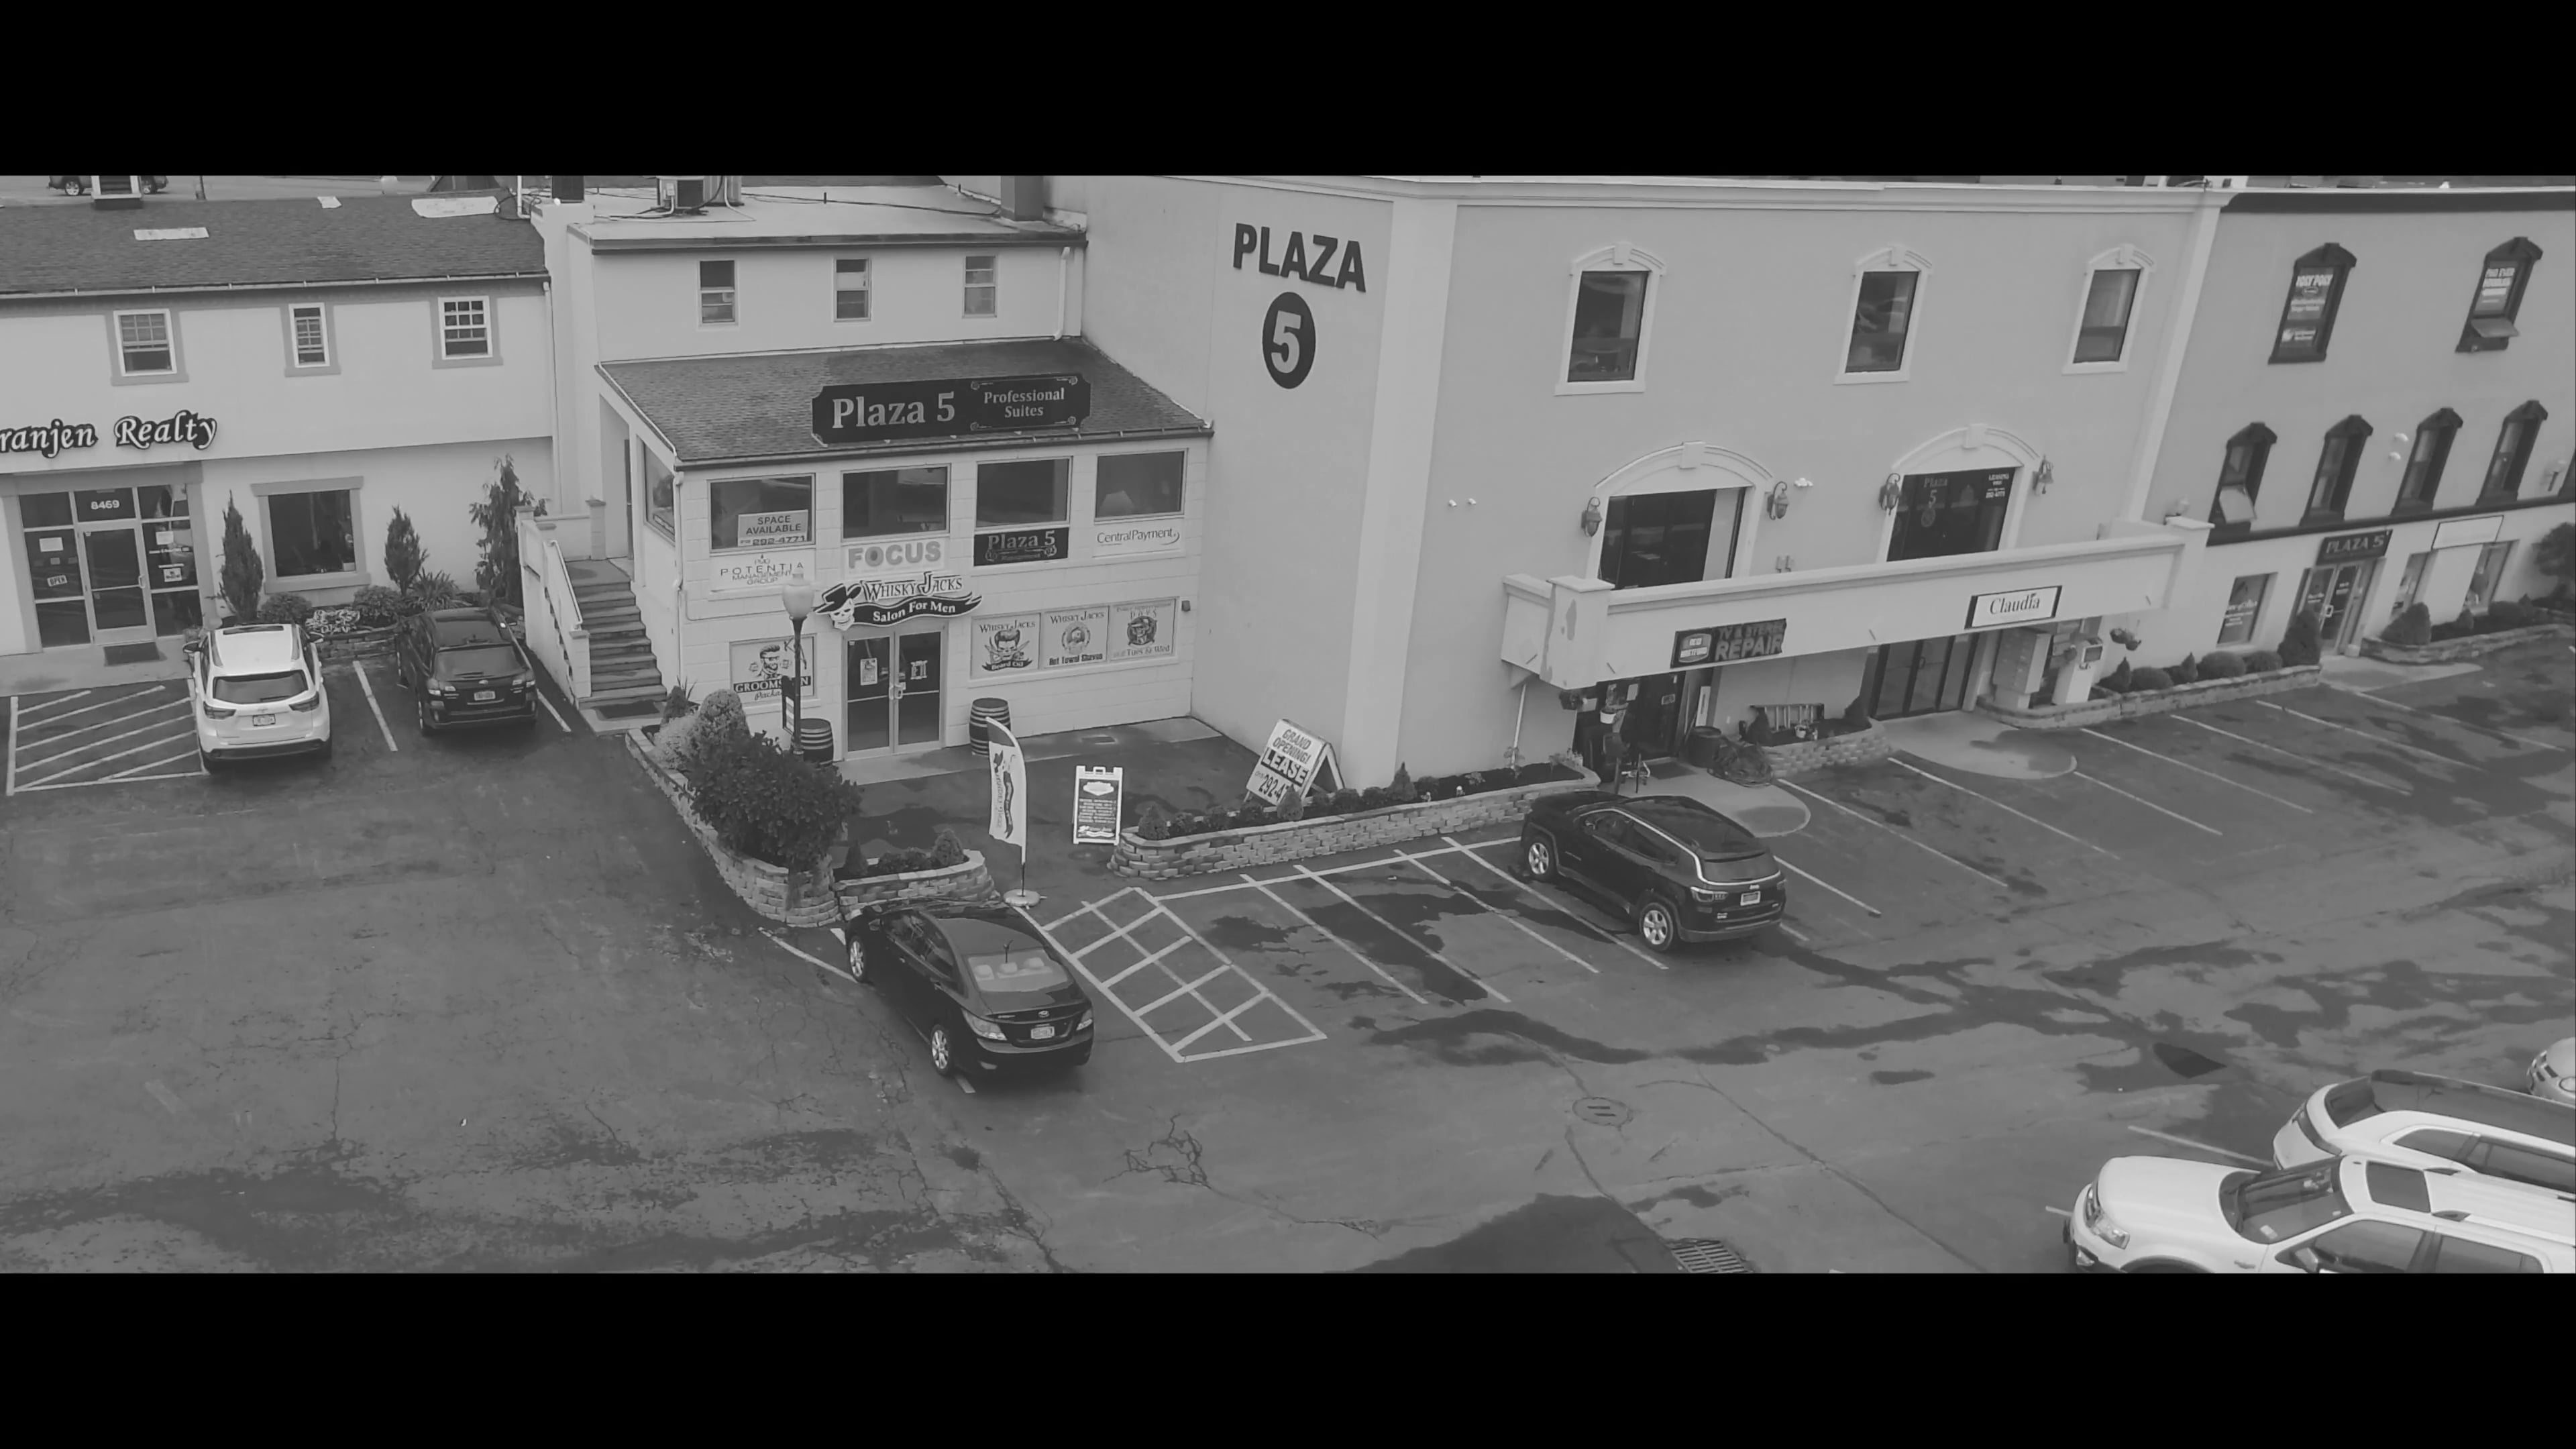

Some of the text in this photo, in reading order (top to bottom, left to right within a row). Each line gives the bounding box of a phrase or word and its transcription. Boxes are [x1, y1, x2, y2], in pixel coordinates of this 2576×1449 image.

[1233, 223, 1366, 292] PLAZA
[1271, 311, 1301, 373] 5
[983, 388, 1065, 404] Professional
[832, 391, 955, 429] Plaza 5
[1005, 405, 1044, 418] Suites
[115, 411, 217, 449] Realty
[91, 500, 119, 510] 8469
[746, 523, 801, 535] AVAILABLE
[757, 515, 791, 525] SPACE
[987, 530, 1055, 550] Plaza 5
[2326, 535, 2384, 553] PLAZA 5
[848, 541, 941, 569] FOCUS
[720, 562, 804, 576] POTENTIA
[873, 601, 956, 623] Salon For Men
[1715, 633, 1783, 661] REPAIR
[735, 676, 810, 692] GROOMSN
[1282, 729, 1311, 750] GRAND
[1273, 737, 1311, 764] OPENING!
[1262, 748, 1309, 784] LEASE
[1258, 774, 1289, 802] 292-4
